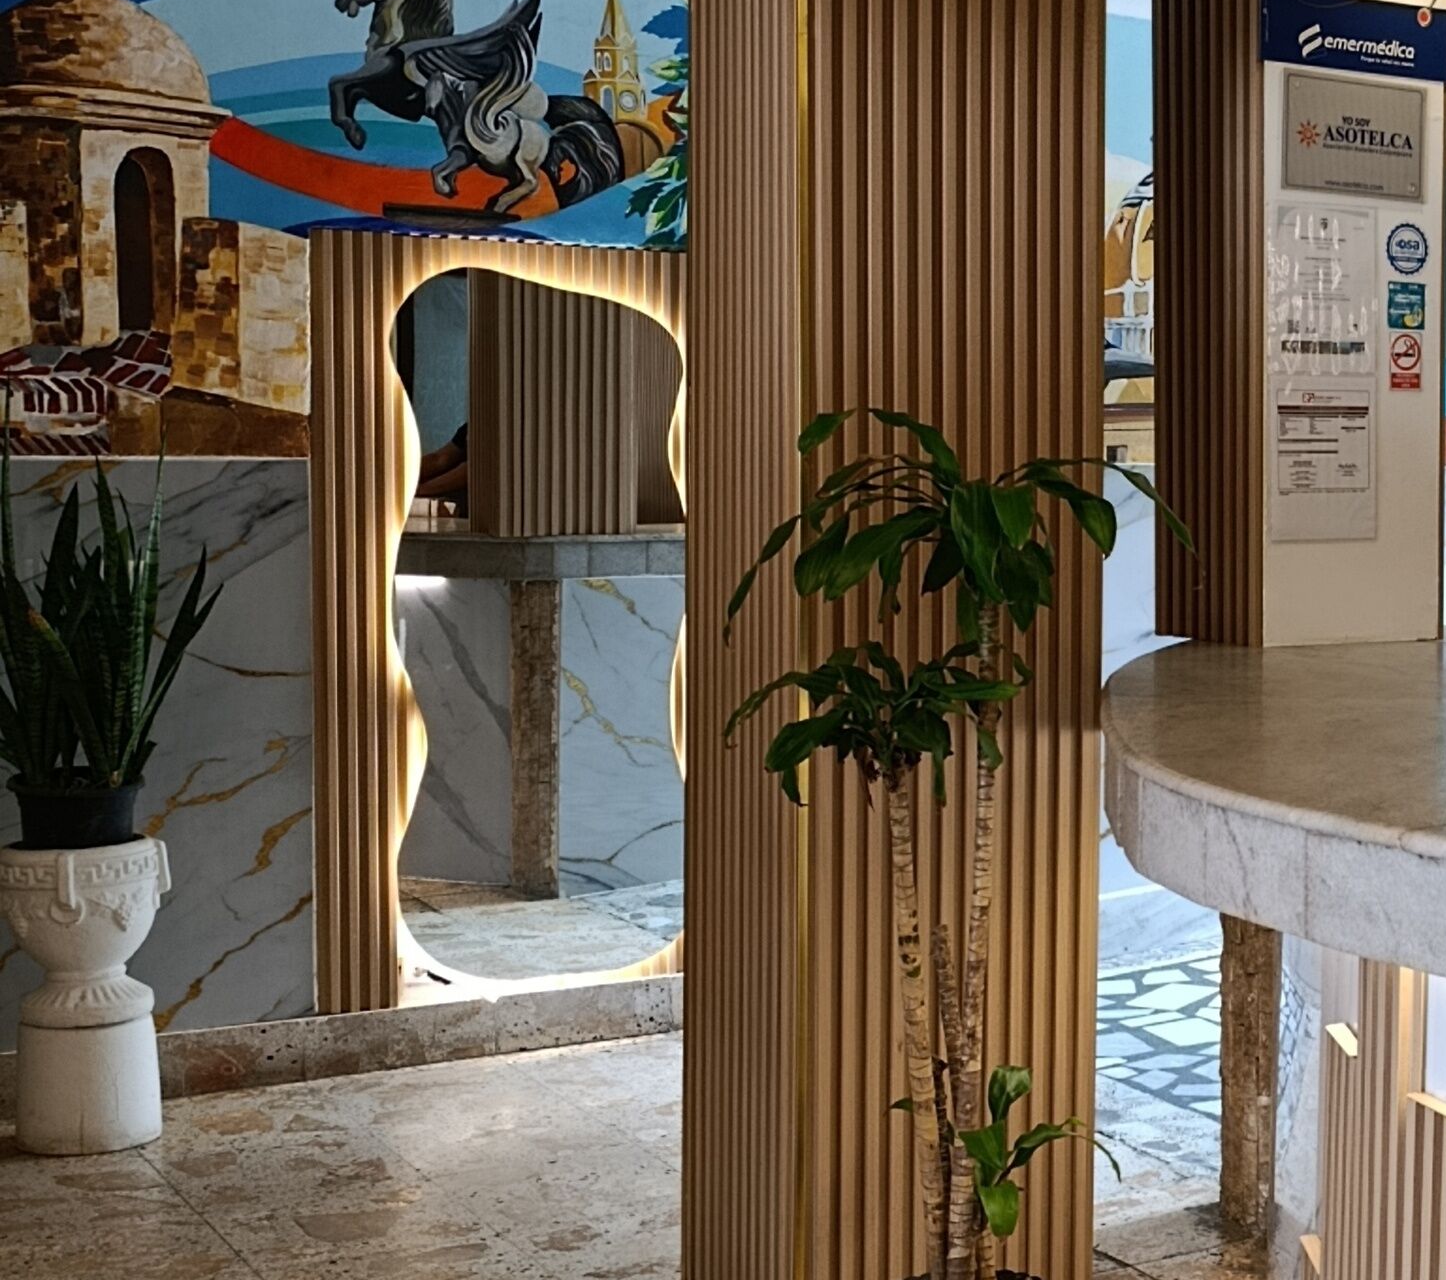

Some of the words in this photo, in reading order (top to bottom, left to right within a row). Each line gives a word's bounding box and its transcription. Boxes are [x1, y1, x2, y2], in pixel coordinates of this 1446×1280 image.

[1324, 36, 1415, 59] emermédica
[1342, 116, 1354, 126] YO
[1355, 118, 1370, 127] SOY
[1324, 125, 1413, 150] ASOTELCA
